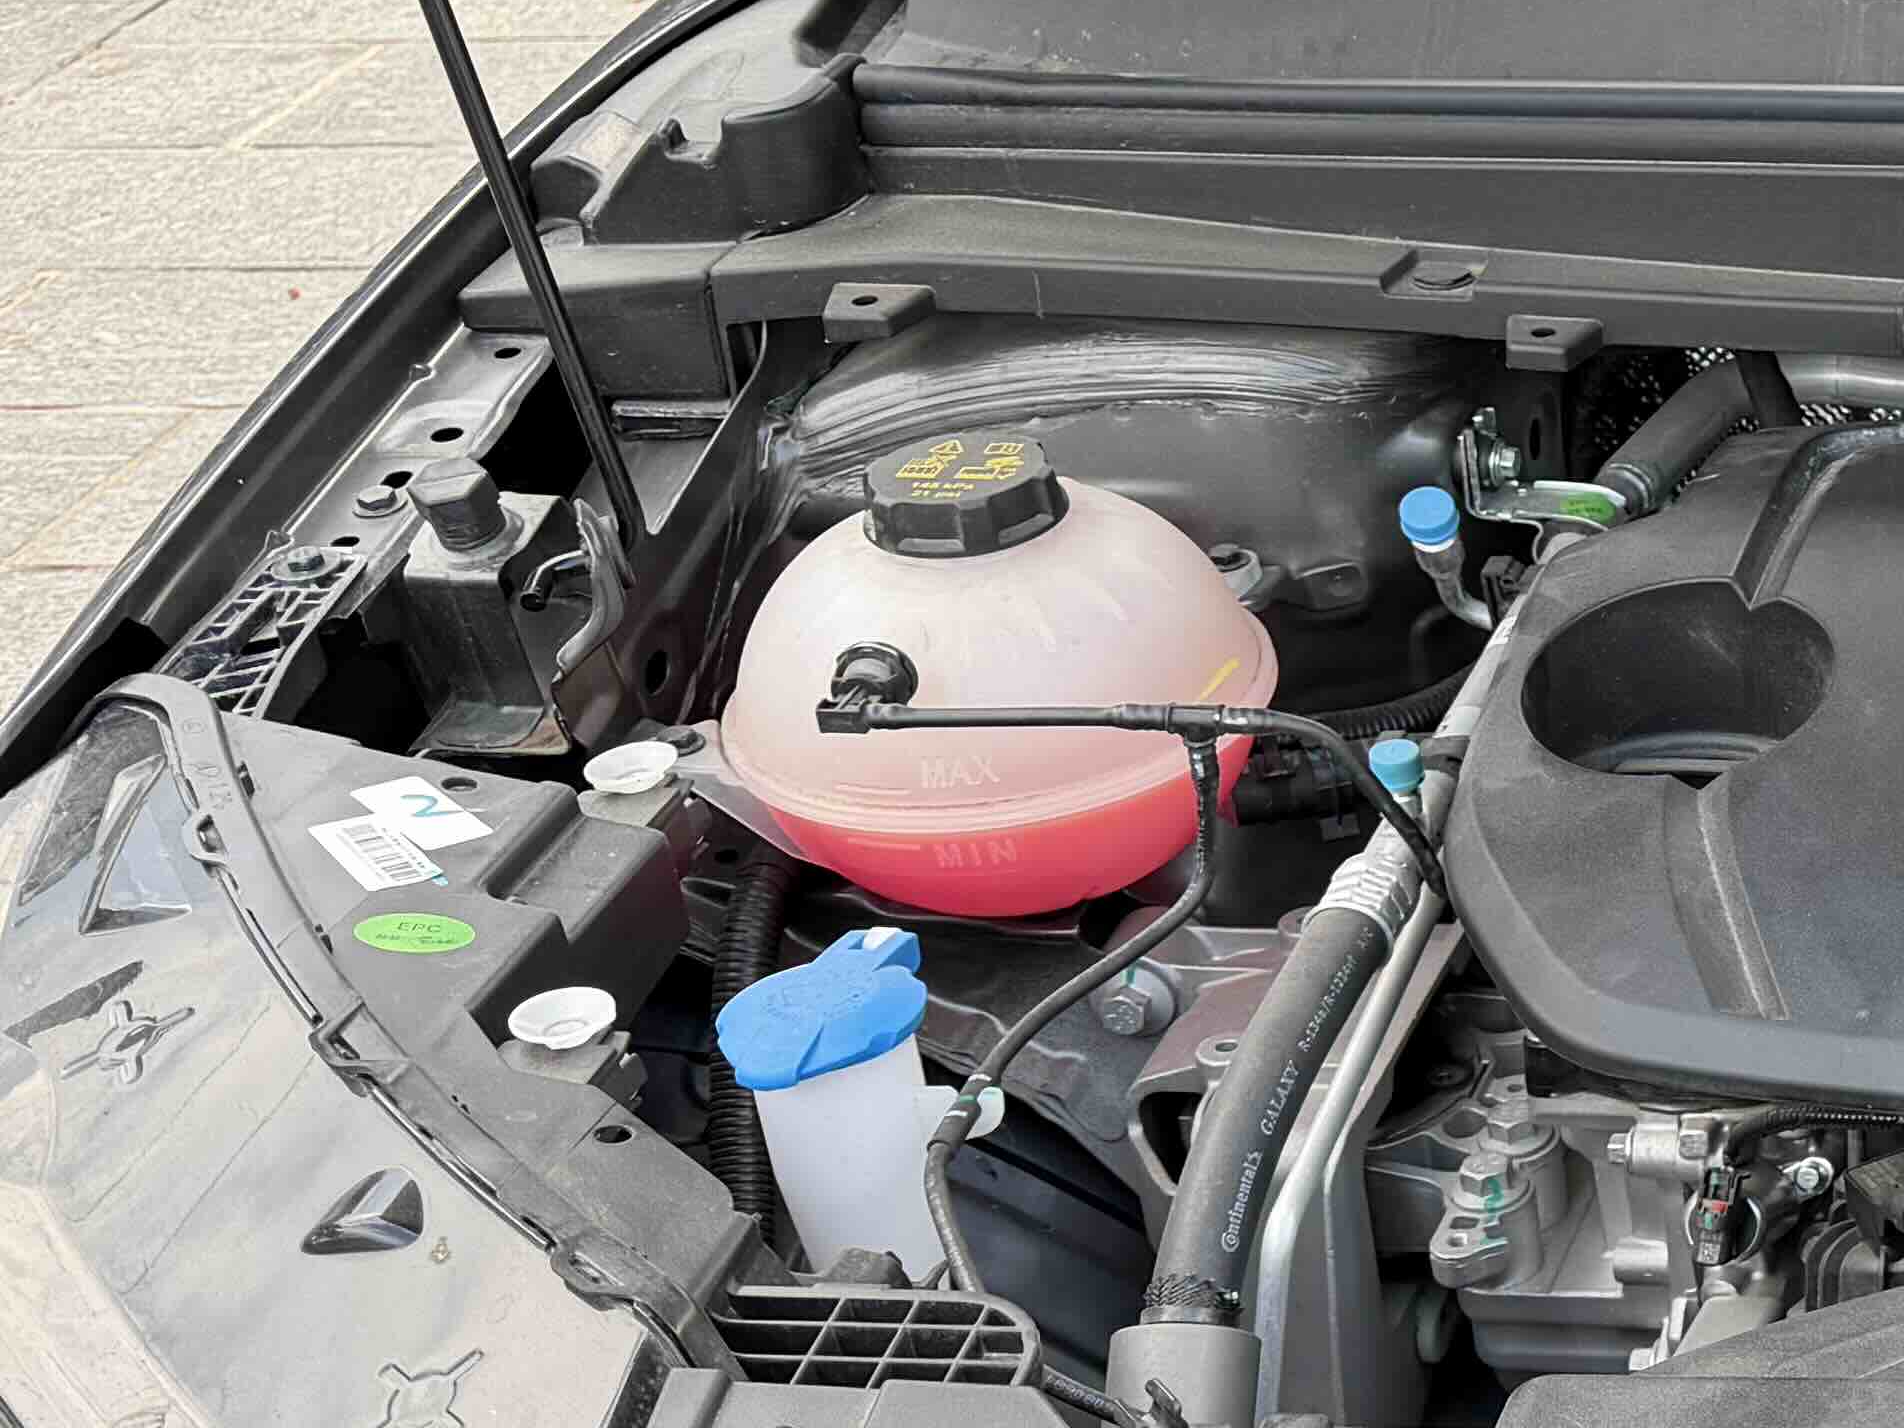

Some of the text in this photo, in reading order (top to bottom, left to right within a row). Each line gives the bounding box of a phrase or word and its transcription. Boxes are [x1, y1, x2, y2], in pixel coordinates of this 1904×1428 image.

[921, 755, 1000, 789] MAX
[935, 838, 1017, 869] MIN
[1260, 1059, 1300, 1137] GALAXY
